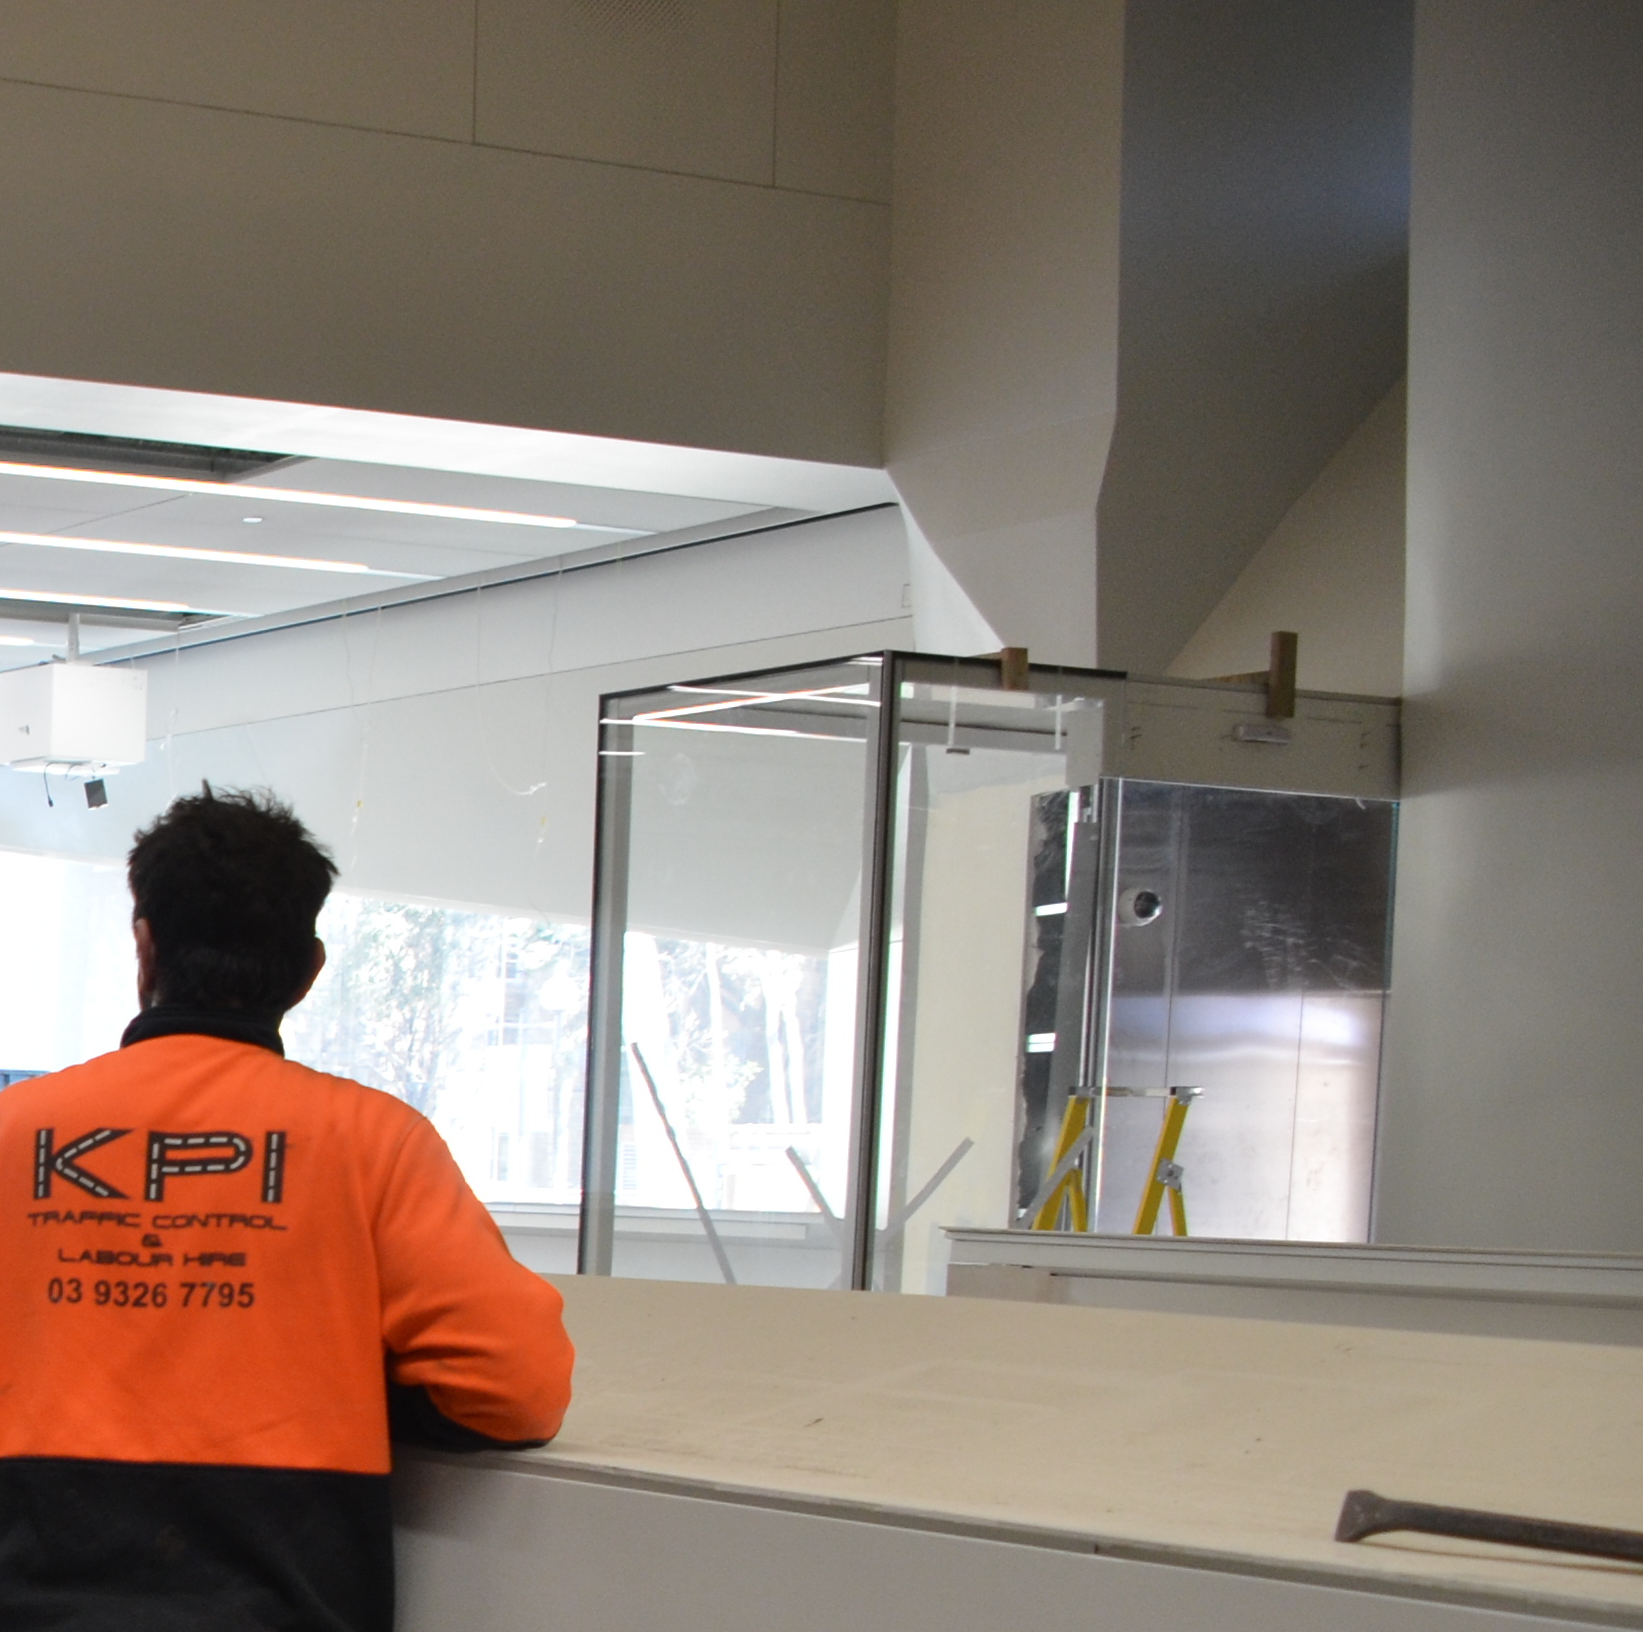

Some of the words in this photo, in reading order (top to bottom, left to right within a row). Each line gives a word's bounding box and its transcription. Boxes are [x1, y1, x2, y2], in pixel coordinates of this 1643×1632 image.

[33, 1127, 287, 1204] KPI
[27, 1211, 142, 1228] TRAFFIC
[152, 1213, 288, 1231] CONTROL
[58, 1248, 173, 1267] LABOUR
[183, 1252, 247, 1267] HIRE
[47, 1277, 83, 1303] 03
[94, 1280, 168, 1308] 9326
[180, 1282, 256, 1308] 7795
